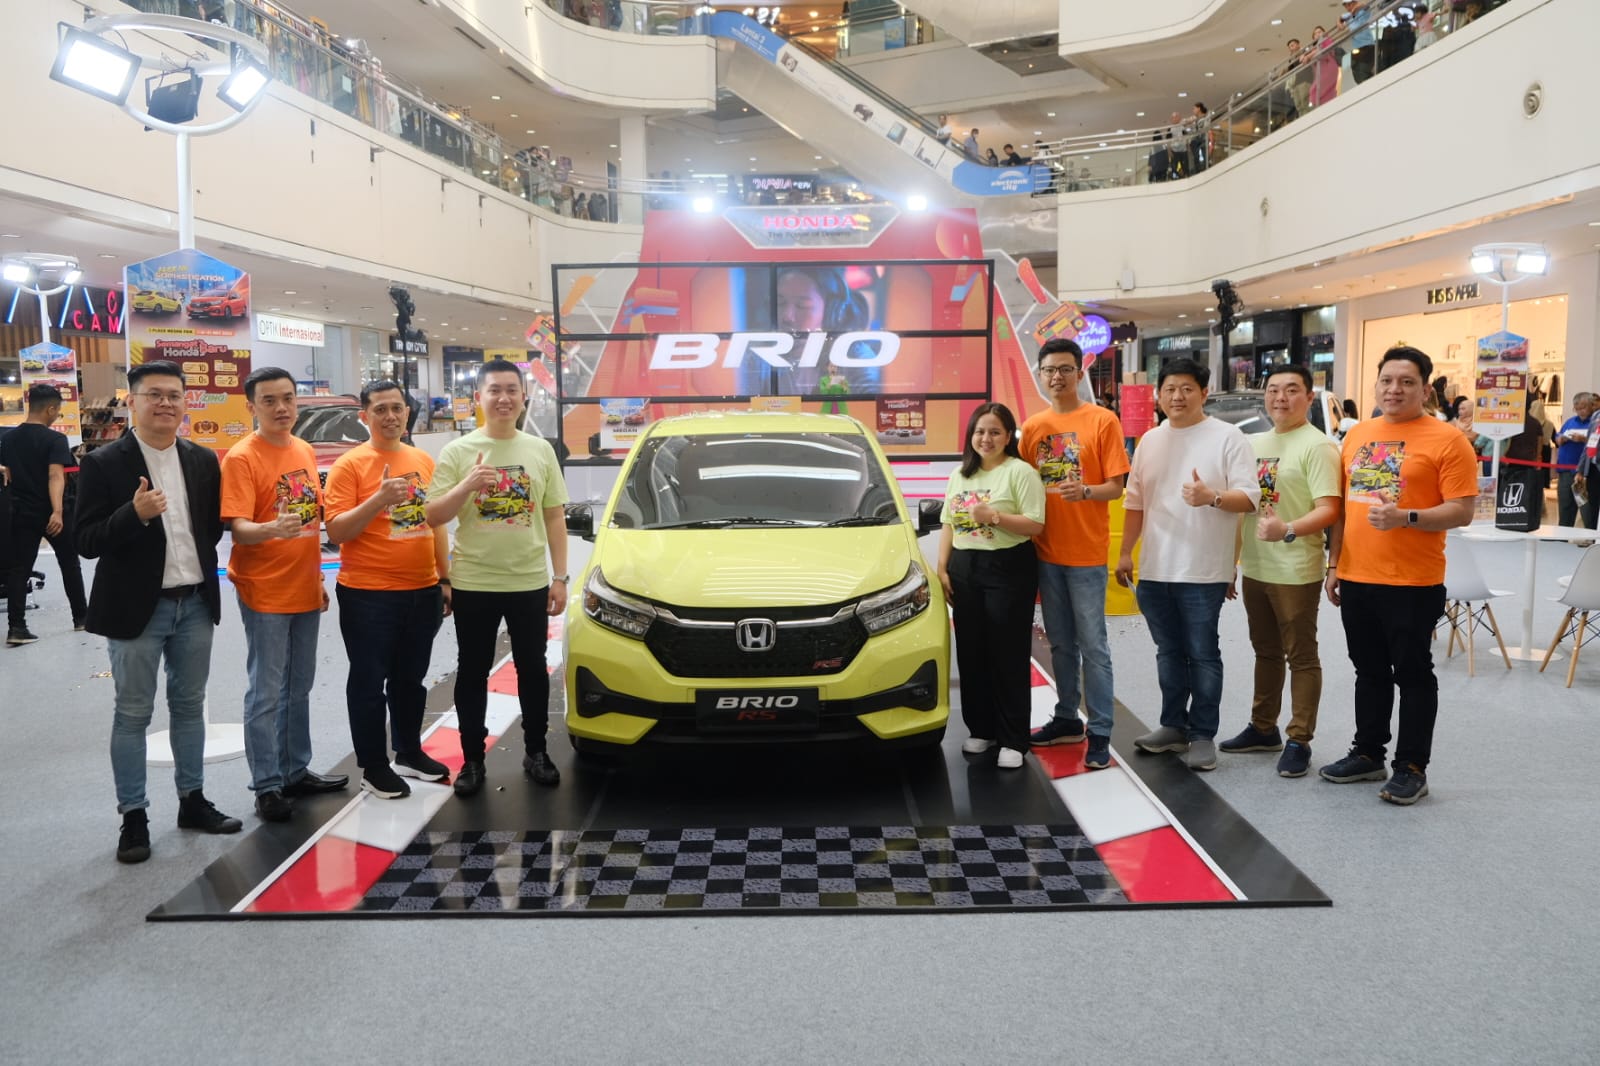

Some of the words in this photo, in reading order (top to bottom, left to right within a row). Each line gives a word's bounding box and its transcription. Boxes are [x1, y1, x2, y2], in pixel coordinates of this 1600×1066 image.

[763, 215, 858, 230] HONDA
[259, 319, 279, 337] OPTIK
[279, 323, 324, 342] Internasional
[163, 347, 200, 357] Honda
[395, 339, 414, 352] TRDY
[648, 331, 901, 370] BRIO
[812, 657, 843, 669] RS
[716, 696, 799, 709] BRIO
[737, 710, 778, 721] RS
